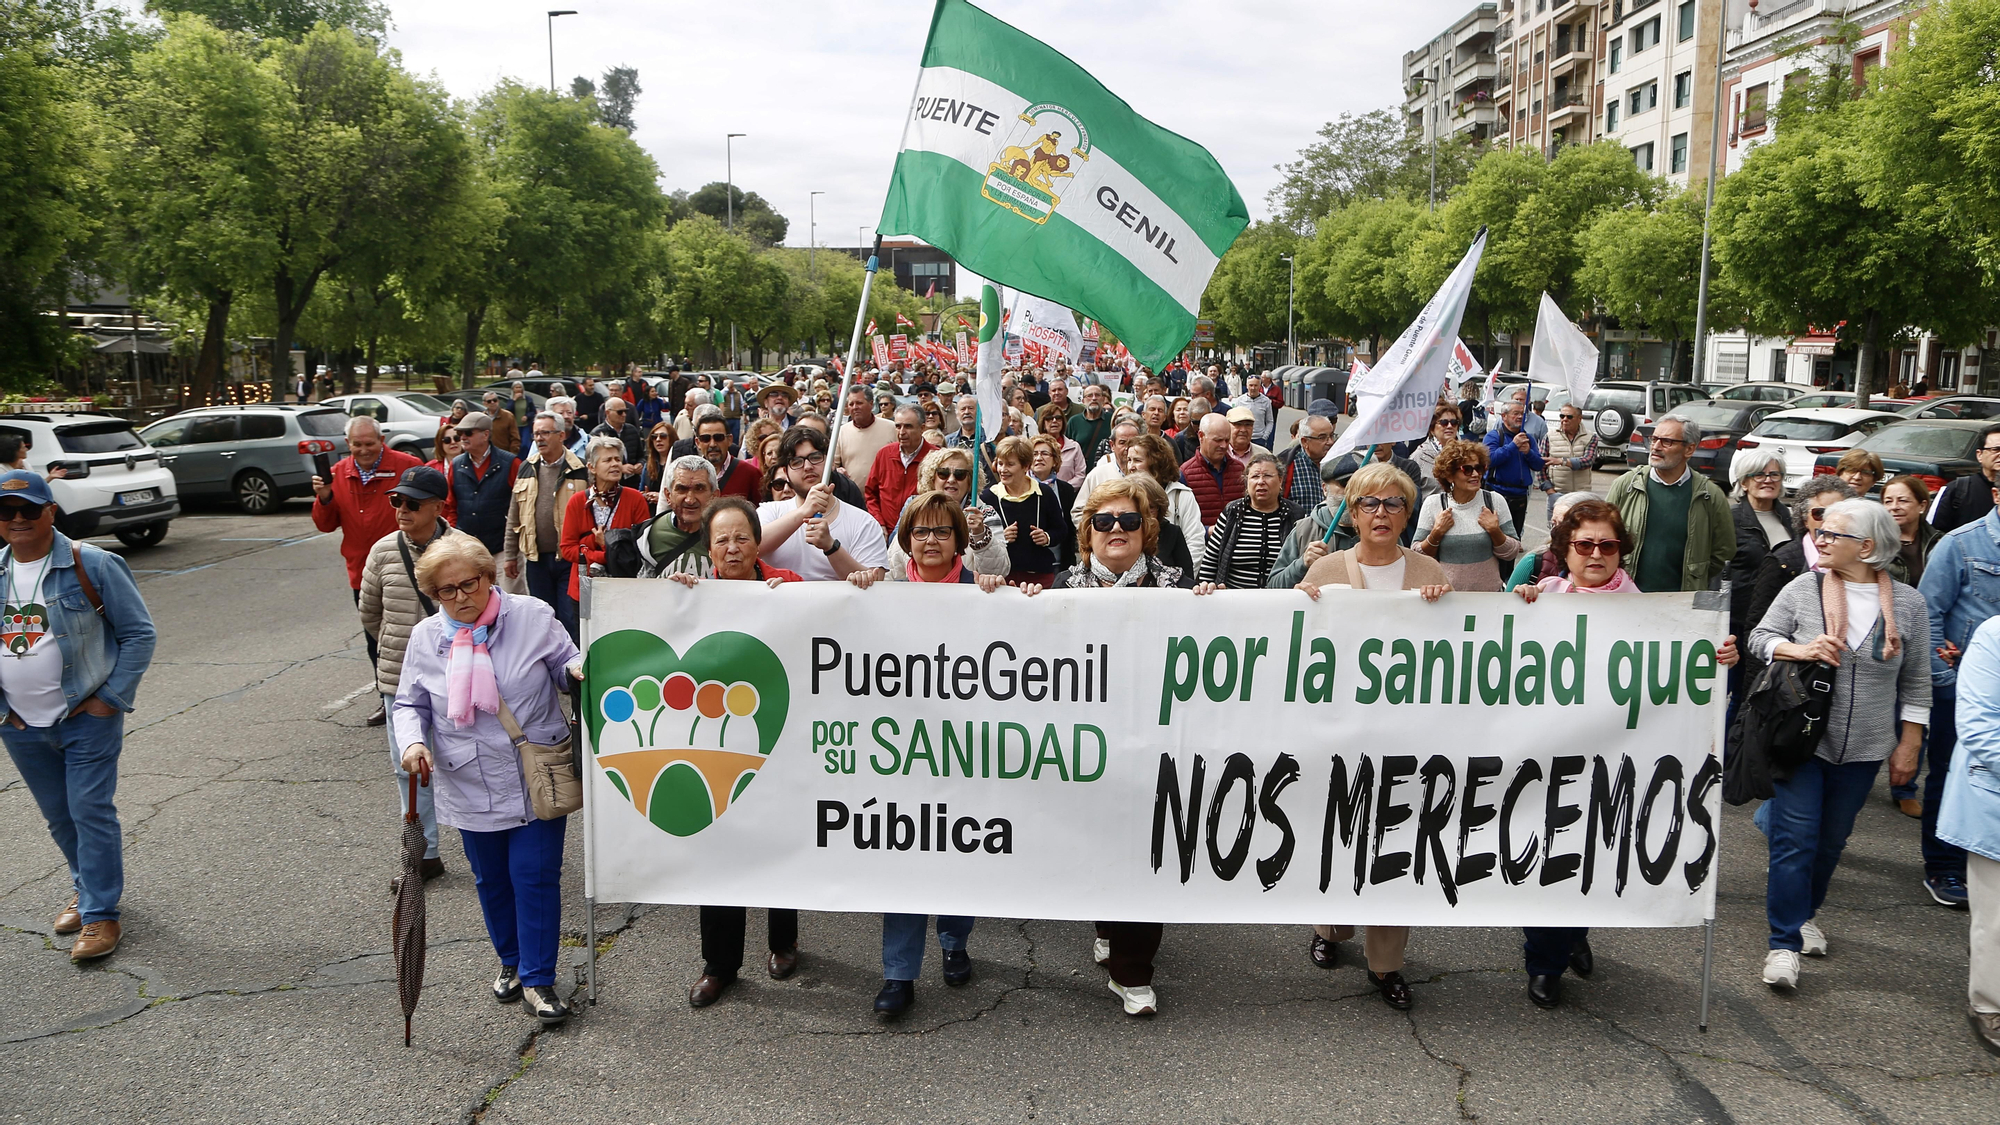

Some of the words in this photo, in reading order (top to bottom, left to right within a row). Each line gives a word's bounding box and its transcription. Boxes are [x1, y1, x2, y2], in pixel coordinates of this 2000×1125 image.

[915, 96, 1000, 135] PUENTE
[996, 181, 1011, 193] POR
[1011, 188, 1039, 207] ESPAÑA
[1096, 184, 1179, 264] GENIL
[1028, 324, 1071, 353] HOSPITAL
[1408, 325, 1423, 348] Puente
[1449, 357, 1464, 378] STEA
[658, 553, 714, 579] MIAM
[811, 636, 1109, 703] PuenteGenil
[1158, 635, 1269, 726] por
[1283, 610, 1337, 704] la
[1354, 613, 1588, 707] sanidad
[1607, 638, 1718, 731] que
[812, 719, 860, 754] por
[868, 716, 1108, 783] SANIDAD
[824, 747, 857, 775] su
[816, 796, 1014, 855] Pública
[1150, 750, 1303, 893] NOS
[1318, 751, 1724, 908] MERECEMOS
